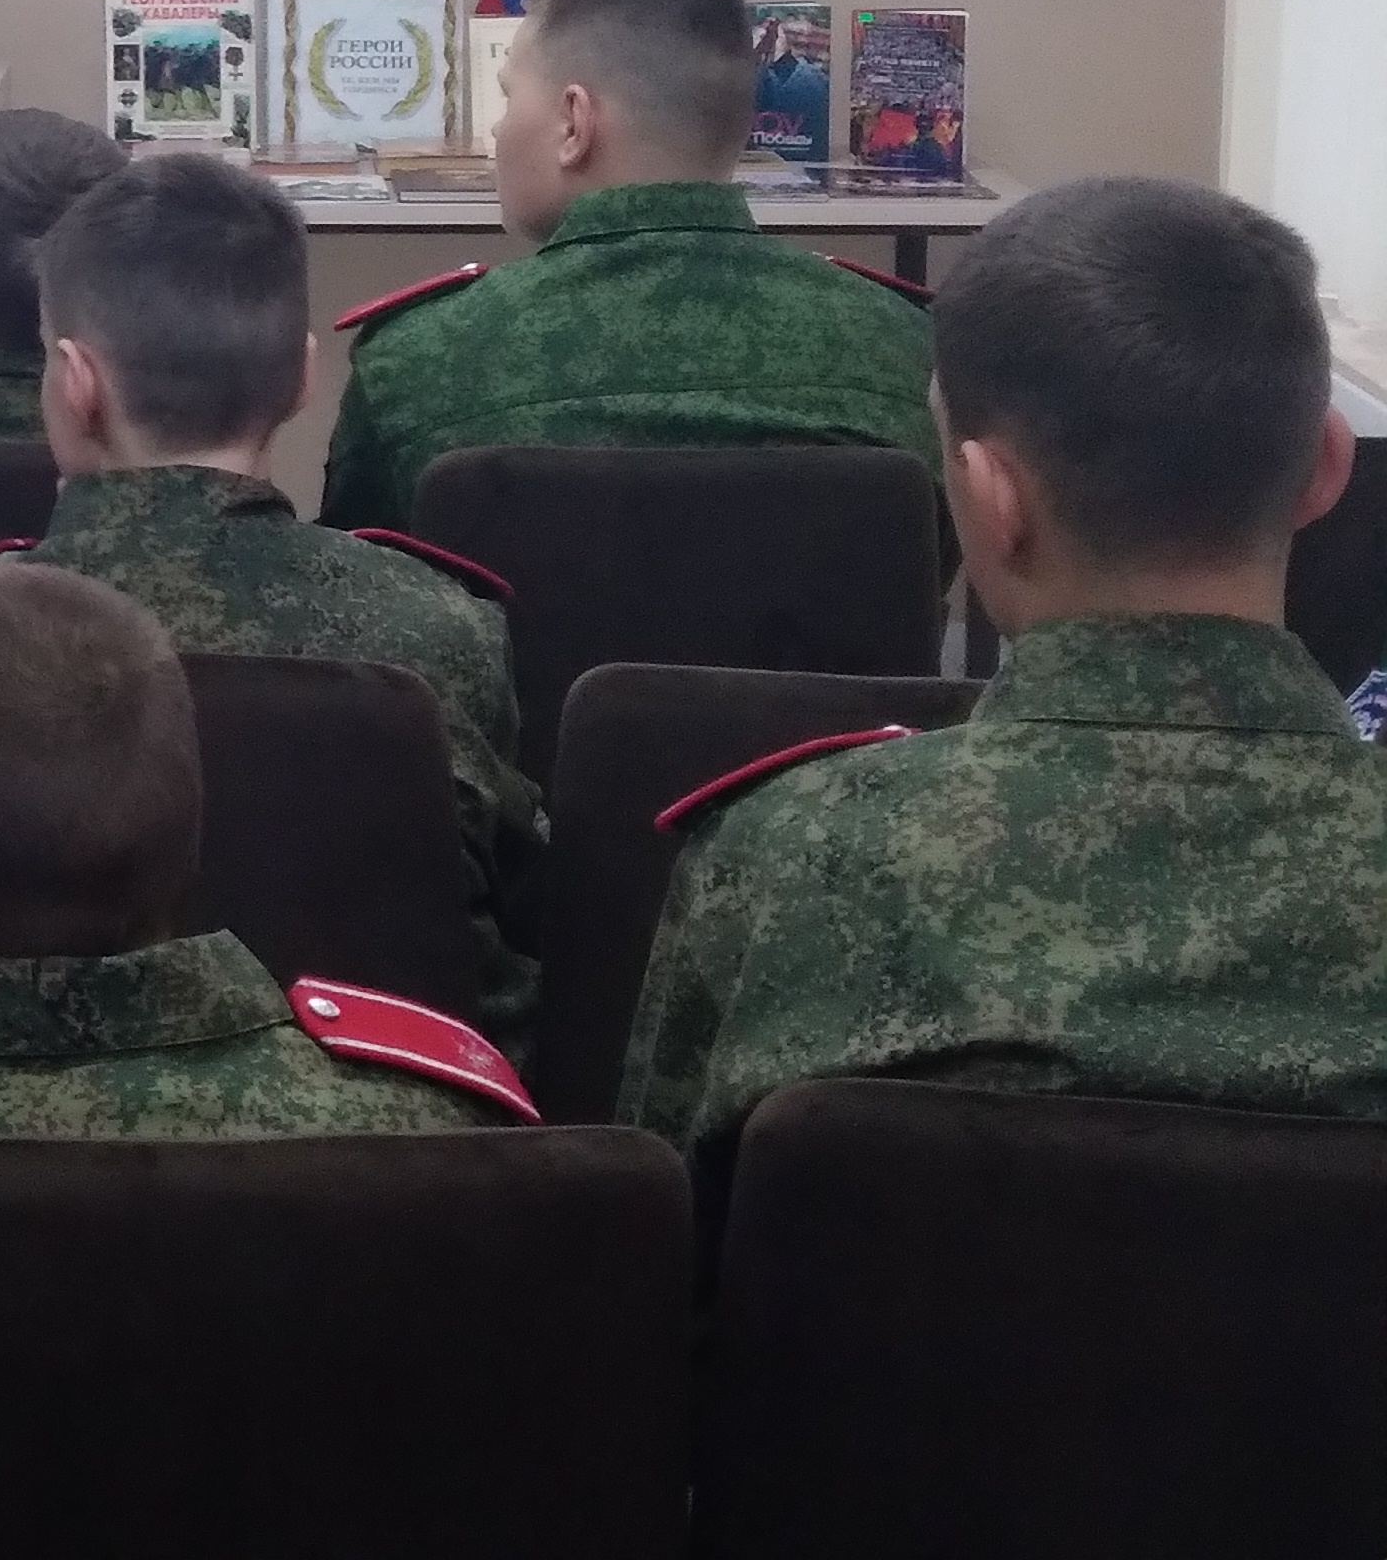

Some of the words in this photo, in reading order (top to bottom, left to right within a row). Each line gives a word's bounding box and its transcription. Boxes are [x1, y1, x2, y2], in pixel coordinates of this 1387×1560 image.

[142, 7, 219, 19] КАВАЛЕРЫ
[336, 39, 404, 53] ГЕРОИ
[329, 55, 413, 69] РОССИИ
